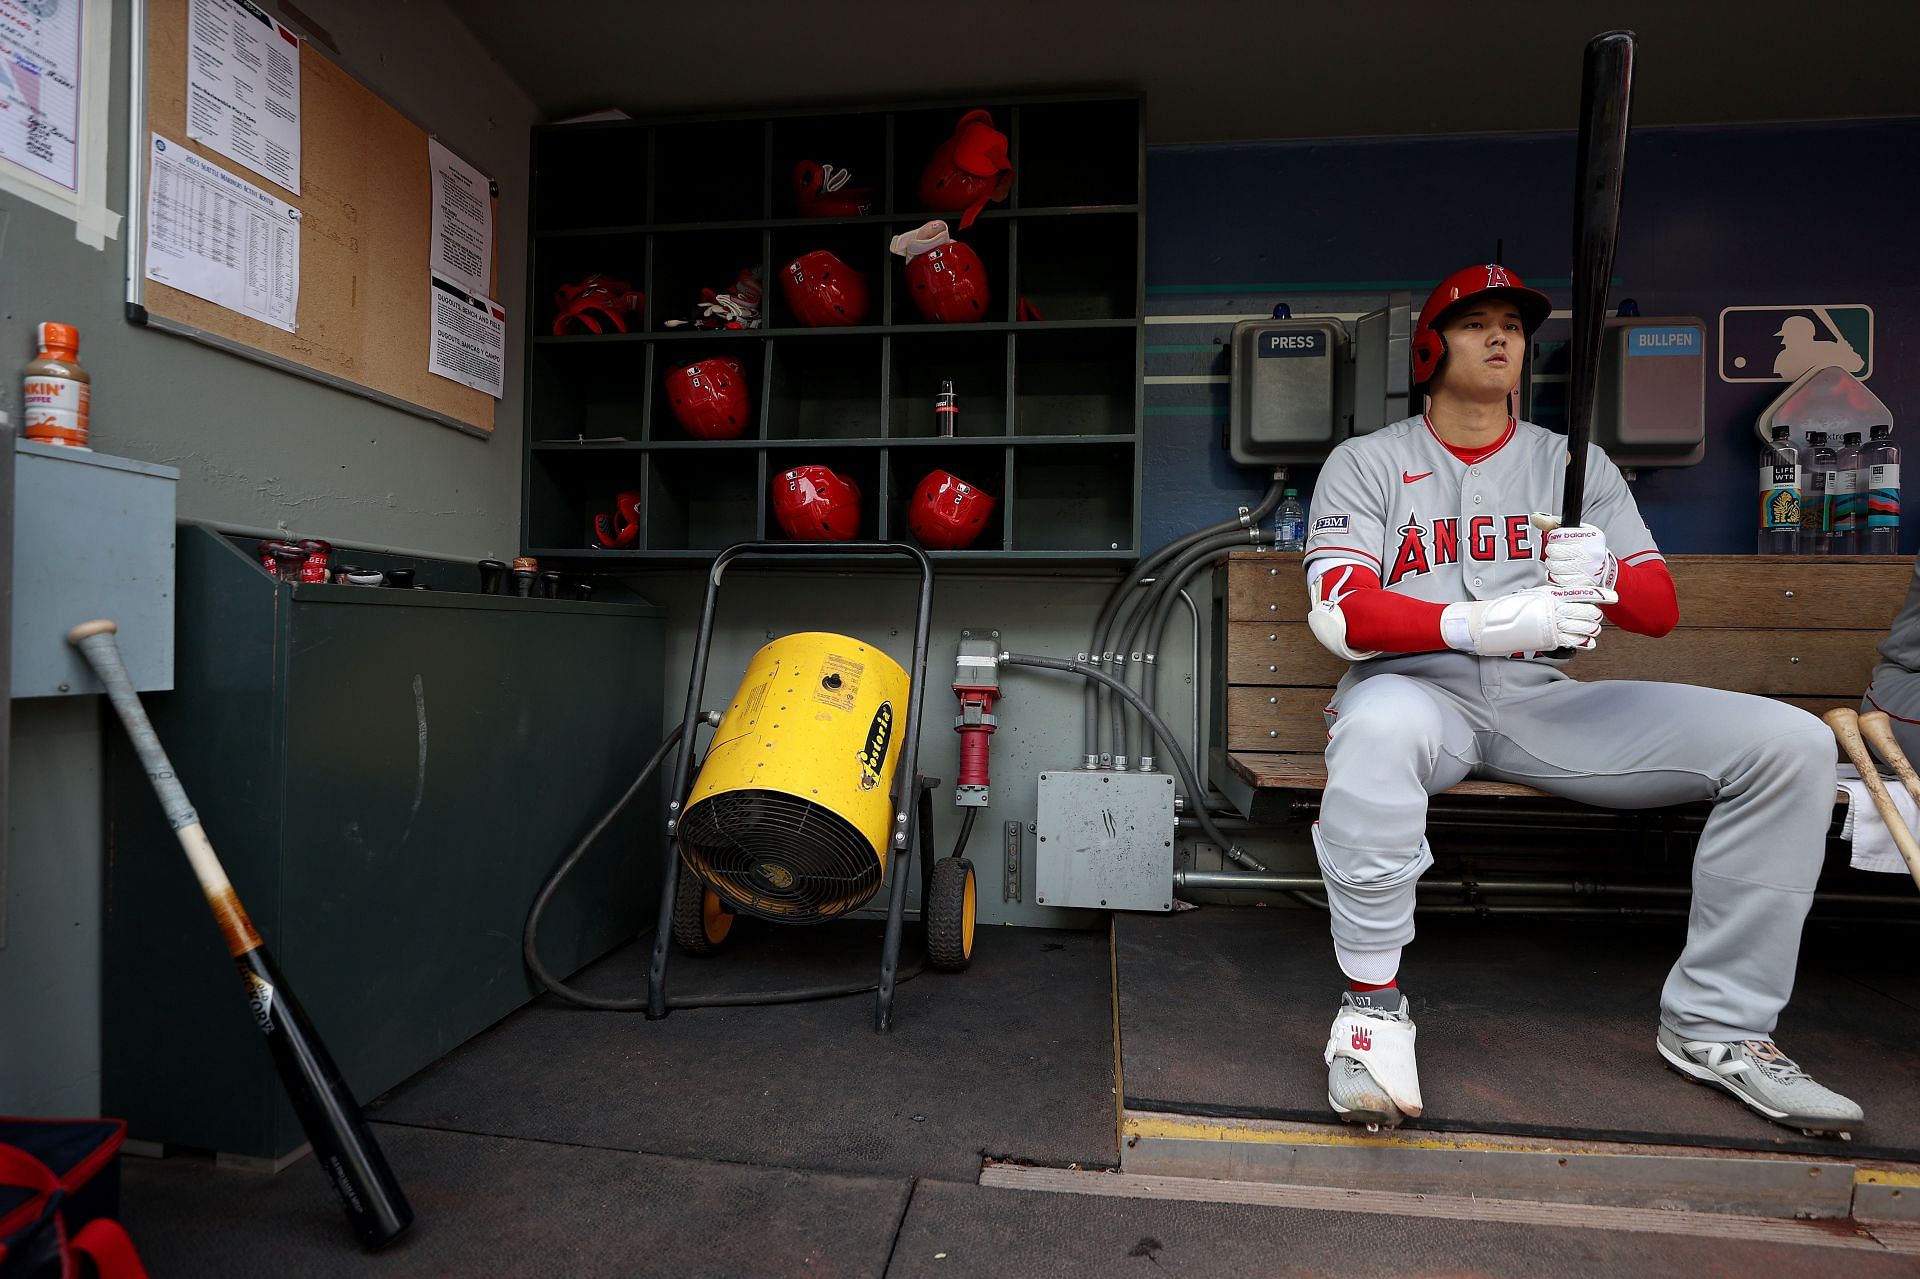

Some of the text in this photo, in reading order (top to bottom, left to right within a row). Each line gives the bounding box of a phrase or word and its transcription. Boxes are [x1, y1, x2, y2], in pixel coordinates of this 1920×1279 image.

[462, 306, 478, 319] BENCH
[479, 315, 489, 324] AND
[490, 320, 501, 330] FIELD
[1271, 335, 1315, 349] PRESS
[1639, 333, 1693, 346] BULLPEN
[1316, 516, 1345, 528] FBM
[1563, 531, 1597, 539] balance
[1563, 589, 1594, 597] balance
